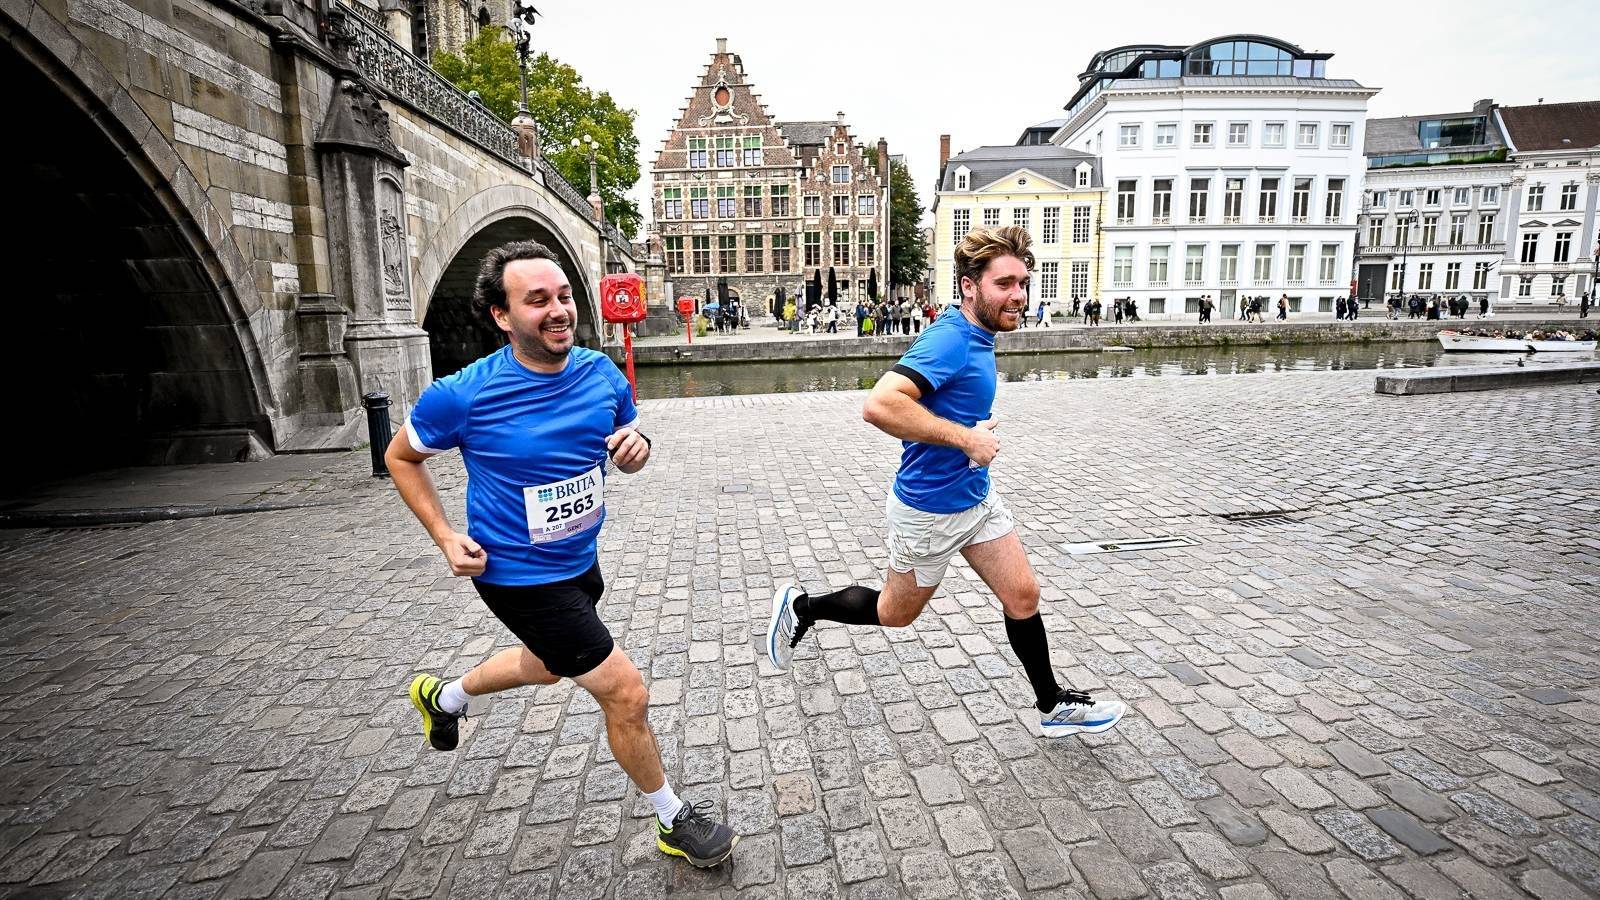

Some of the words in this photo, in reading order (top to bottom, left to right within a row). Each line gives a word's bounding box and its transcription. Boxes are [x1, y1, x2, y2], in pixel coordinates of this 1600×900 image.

[555, 475, 596, 499] BRITA
[545, 493, 594, 523] 2563
[567, 523, 583, 533] GENT
